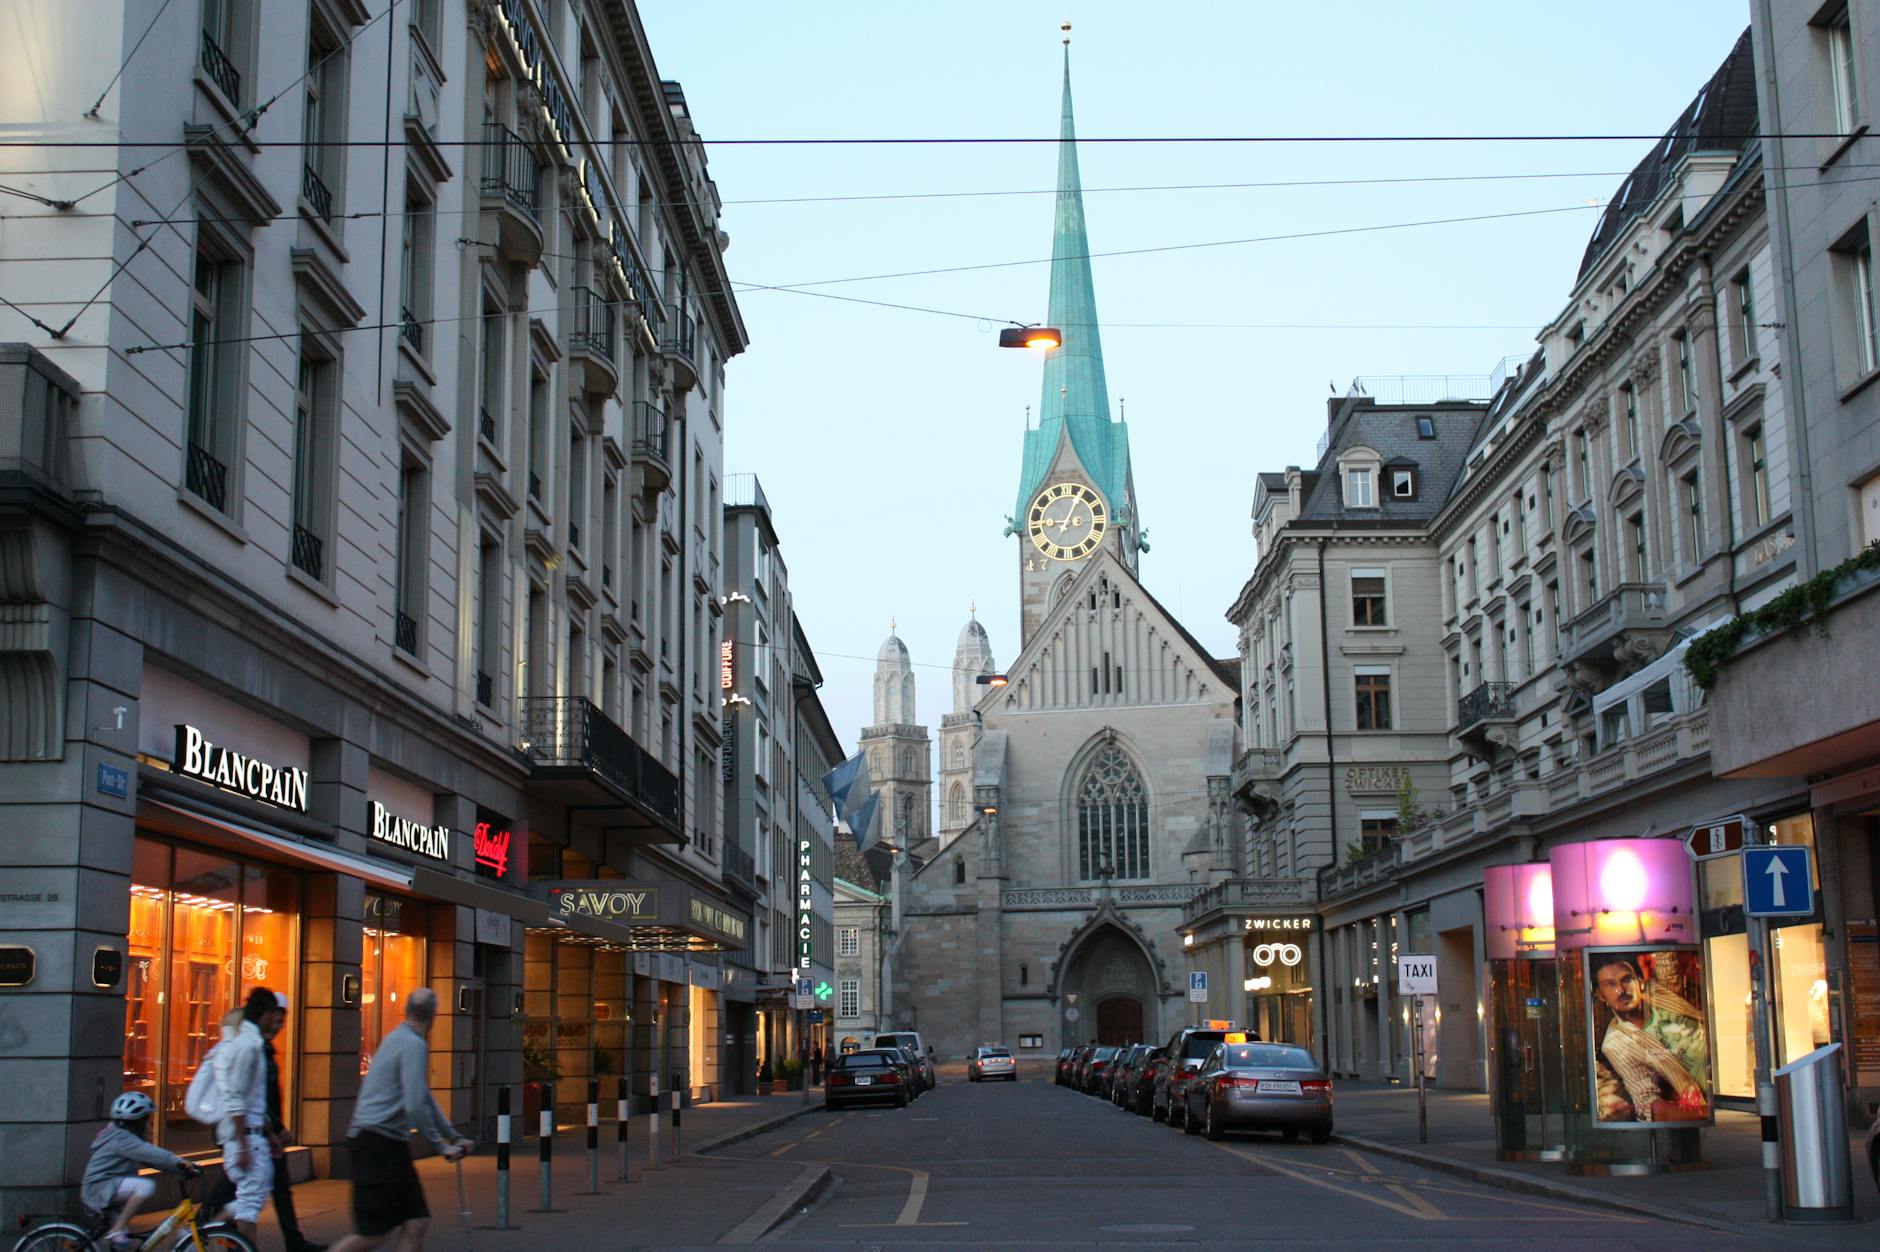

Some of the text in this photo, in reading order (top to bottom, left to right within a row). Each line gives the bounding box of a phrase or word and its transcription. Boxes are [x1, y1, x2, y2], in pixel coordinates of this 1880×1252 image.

[722, 639, 733, 689] COIFFURE
[183, 724, 308, 813] BLANCPAIN
[1345, 778, 1402, 789] ZWICKE
[373, 801, 449, 860] BLANCPAIN
[0, 894, 42, 903] STRASSE
[560, 893, 646, 916] SAVOY
[800, 840, 811, 969] PHARMACIE
[1244, 918, 1311, 929] ZWICKER
[1404, 964, 1433, 978] TAXI
